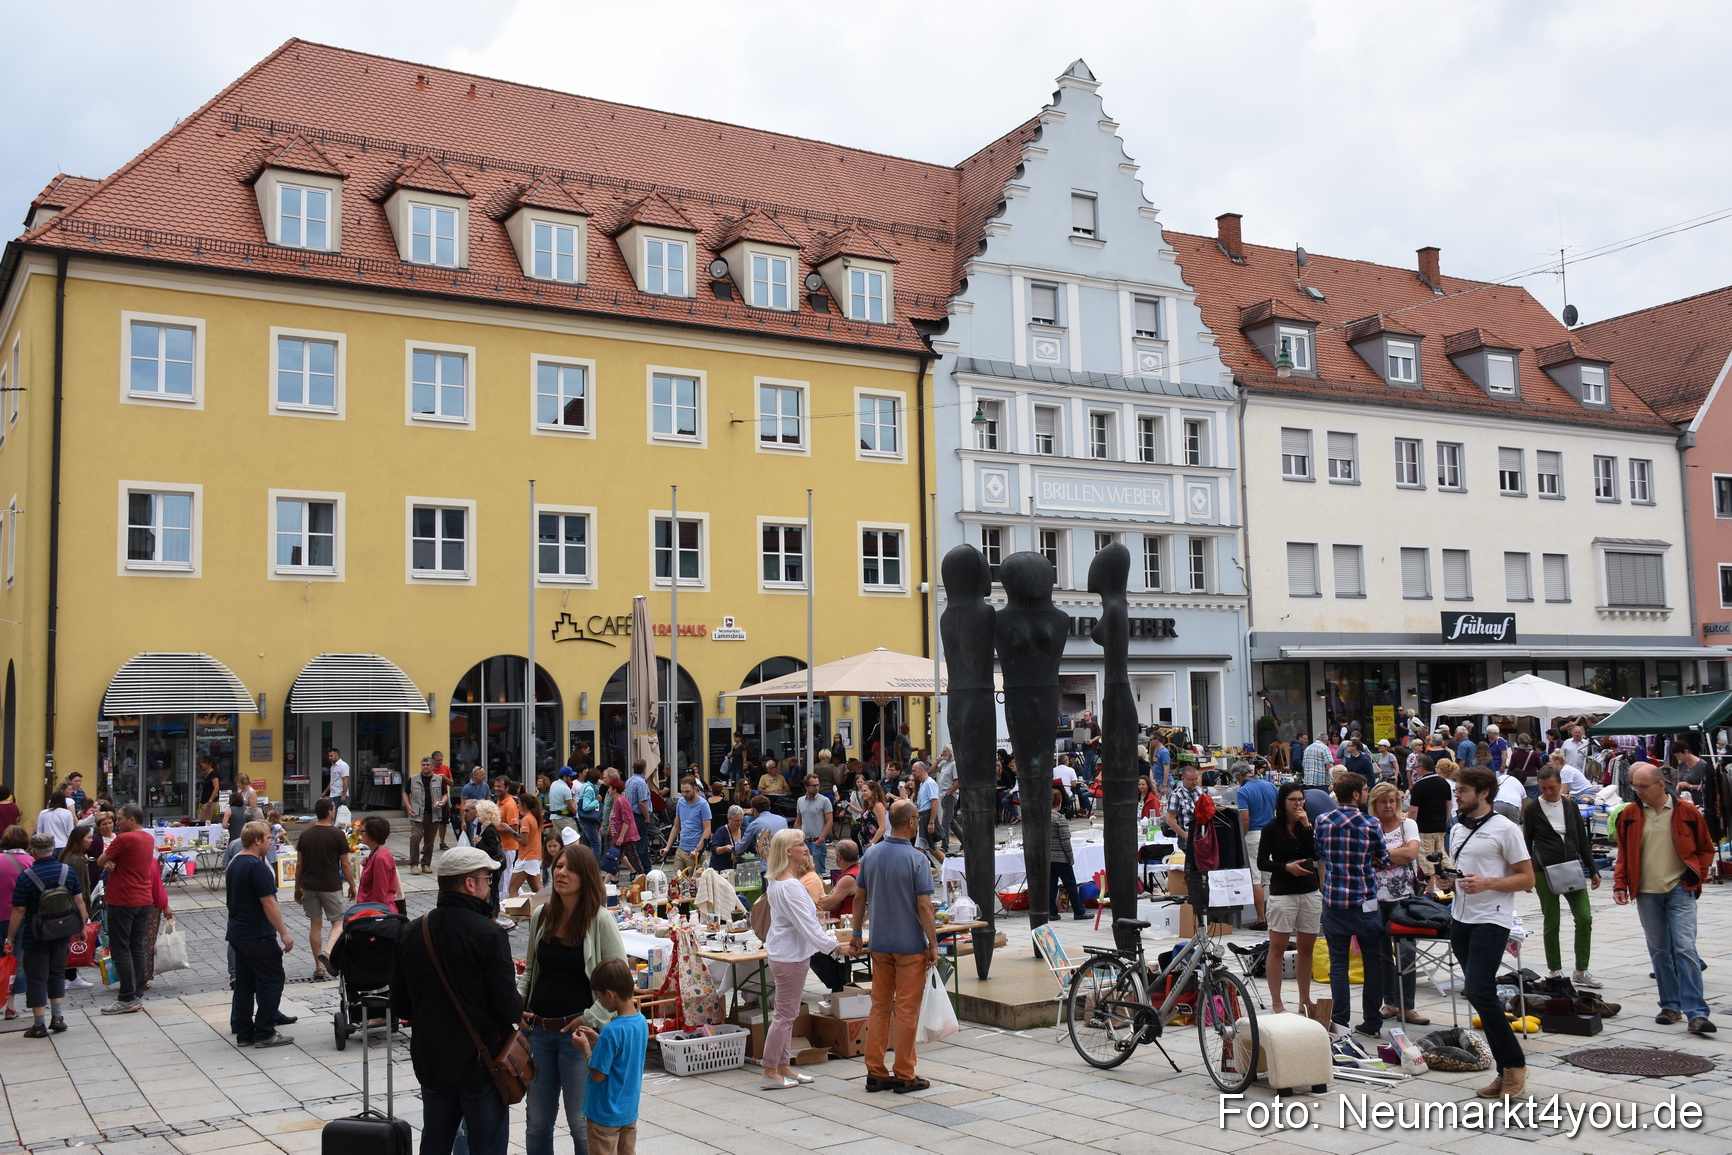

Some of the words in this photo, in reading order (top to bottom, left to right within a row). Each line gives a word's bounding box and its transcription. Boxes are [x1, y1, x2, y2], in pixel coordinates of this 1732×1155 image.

[1042, 481, 1104, 502] BRILLEN
[1106, 486, 1162, 506] WEBER
[587, 613, 633, 635] CAFÉ
[659, 623, 707, 637] RAHAUS
[1128, 617, 1179, 638] EBER
[1446, 614, 1514, 641] frühauf
[911, 697, 921, 705] 24
